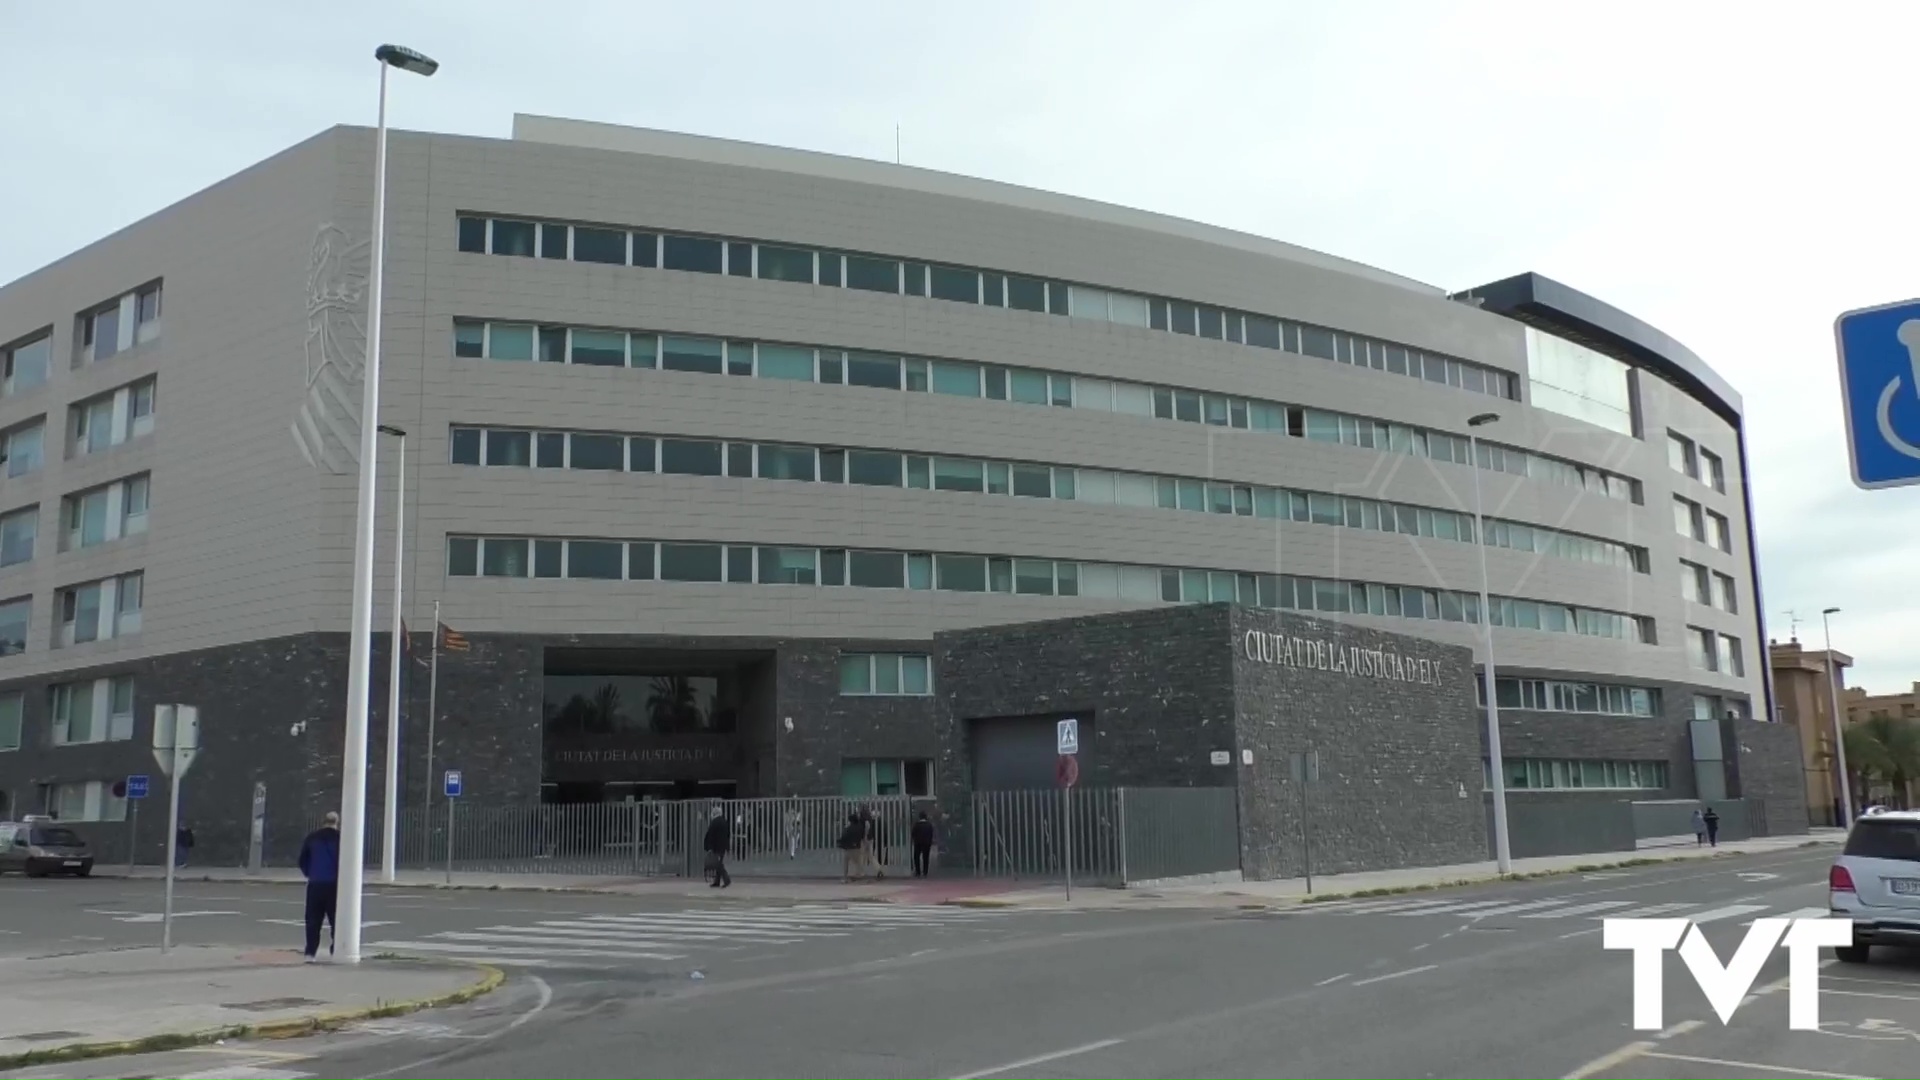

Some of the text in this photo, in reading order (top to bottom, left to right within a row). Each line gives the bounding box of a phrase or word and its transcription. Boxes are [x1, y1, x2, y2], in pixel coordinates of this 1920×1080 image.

[1244, 629, 1304, 667] CIUTAT
[1306, 637, 1328, 670] DE
[1329, 643, 1348, 673] LA
